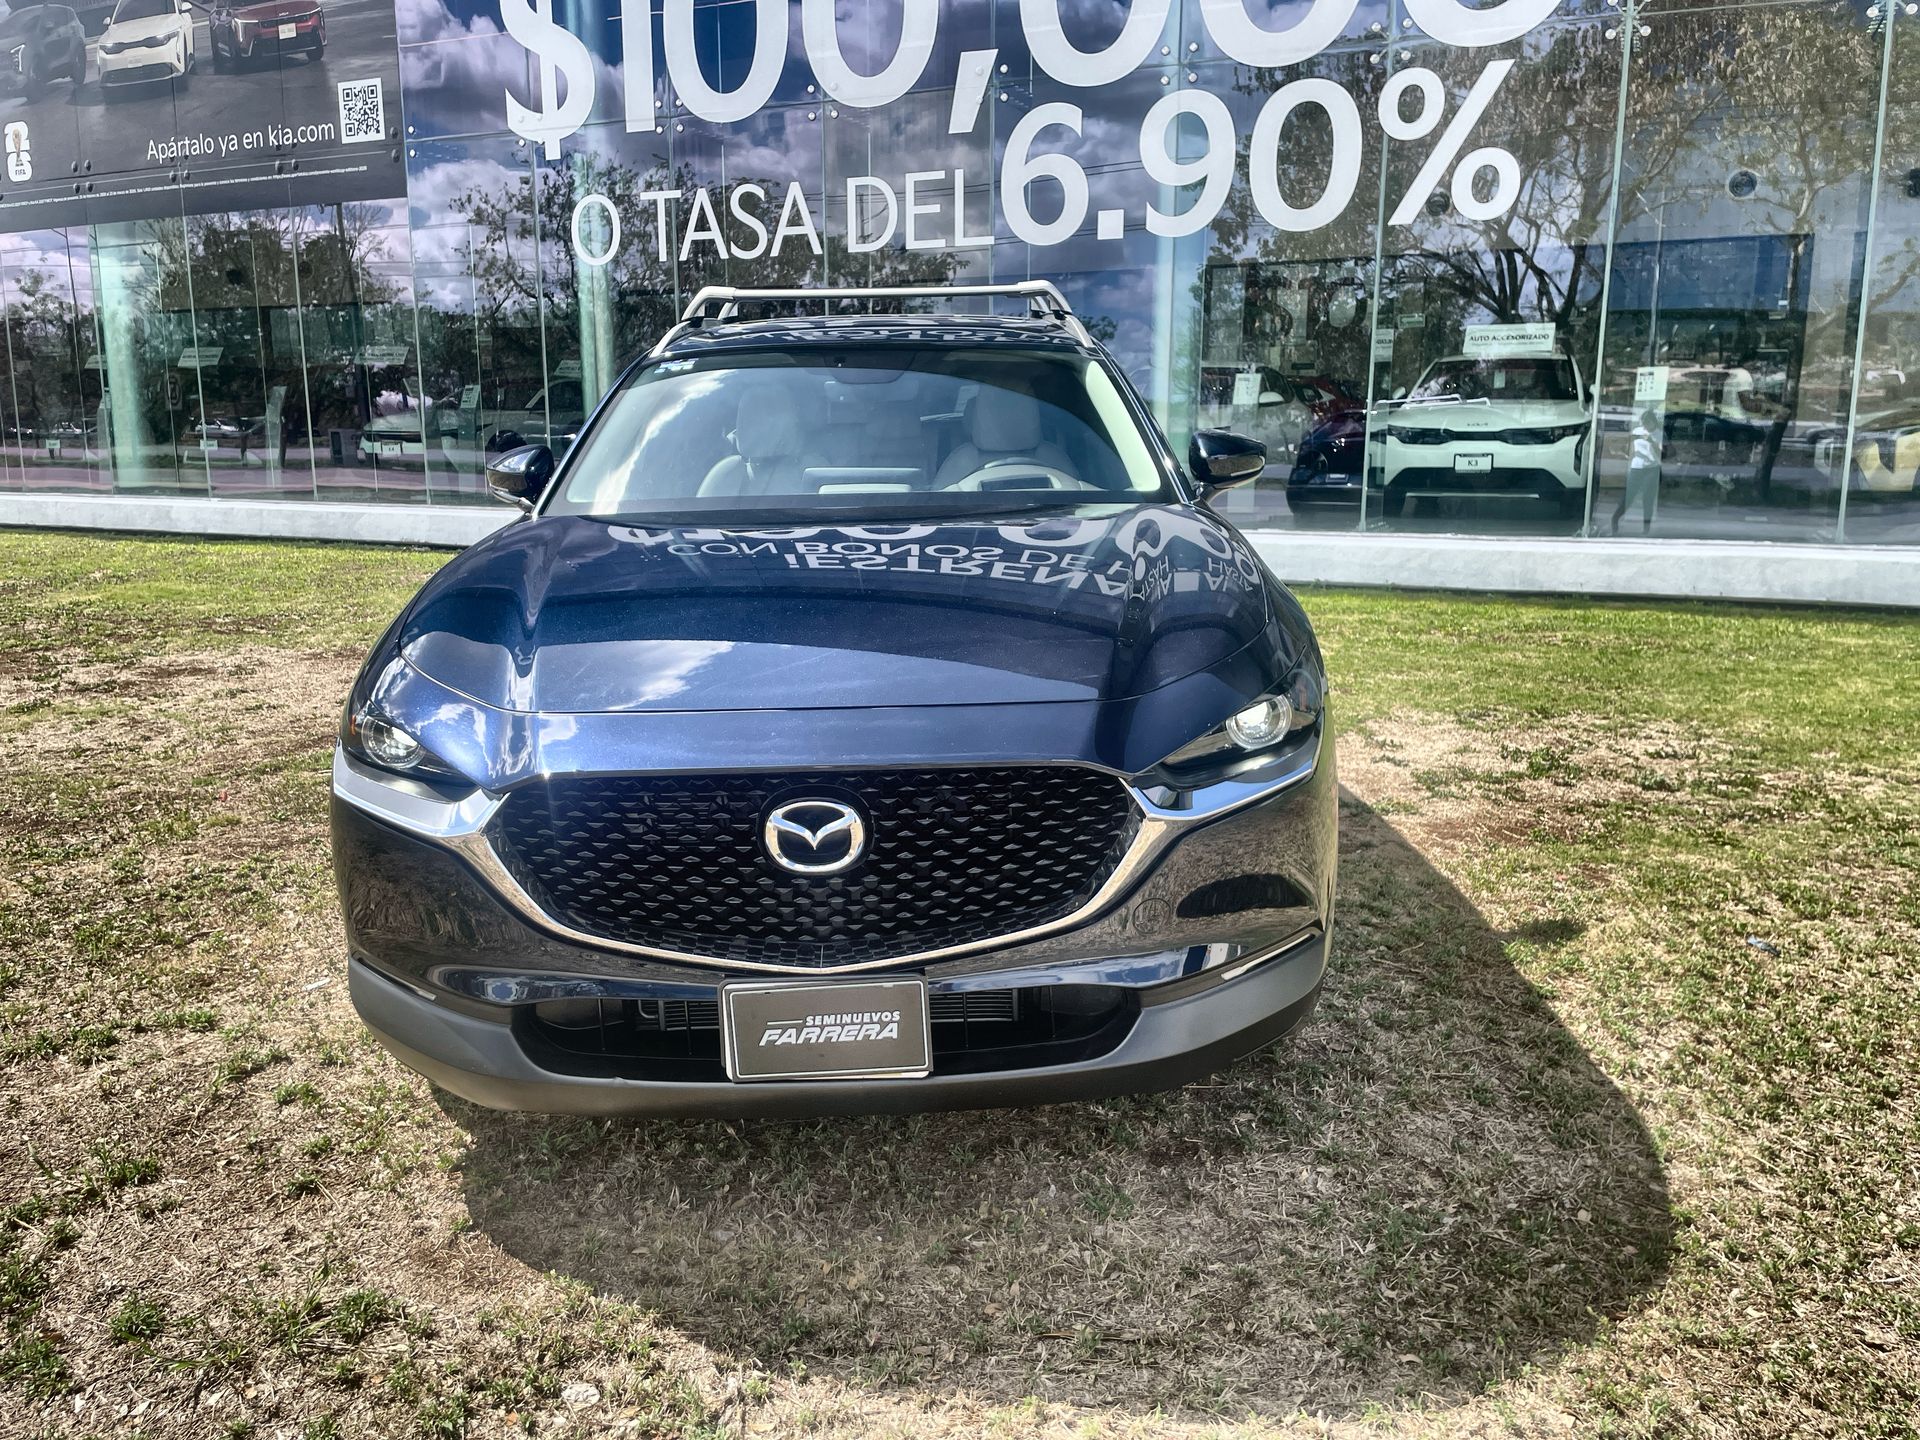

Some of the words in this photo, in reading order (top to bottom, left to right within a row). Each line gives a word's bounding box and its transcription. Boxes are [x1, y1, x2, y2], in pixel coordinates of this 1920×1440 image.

[147, 133, 214, 164] Apártalo
[218, 134, 238, 157] ya
[243, 131, 263, 148] en
[268, 122, 335, 147] kia.com
[571, 194, 621, 266] O
[640, 182, 823, 262] TASA
[847, 169, 995, 252] DEL
[1001, 59, 1521, 246] 6.90%
[758, 1022, 898, 1046] FARRERA
[806, 1011, 900, 1026] SEMINUEVOS
